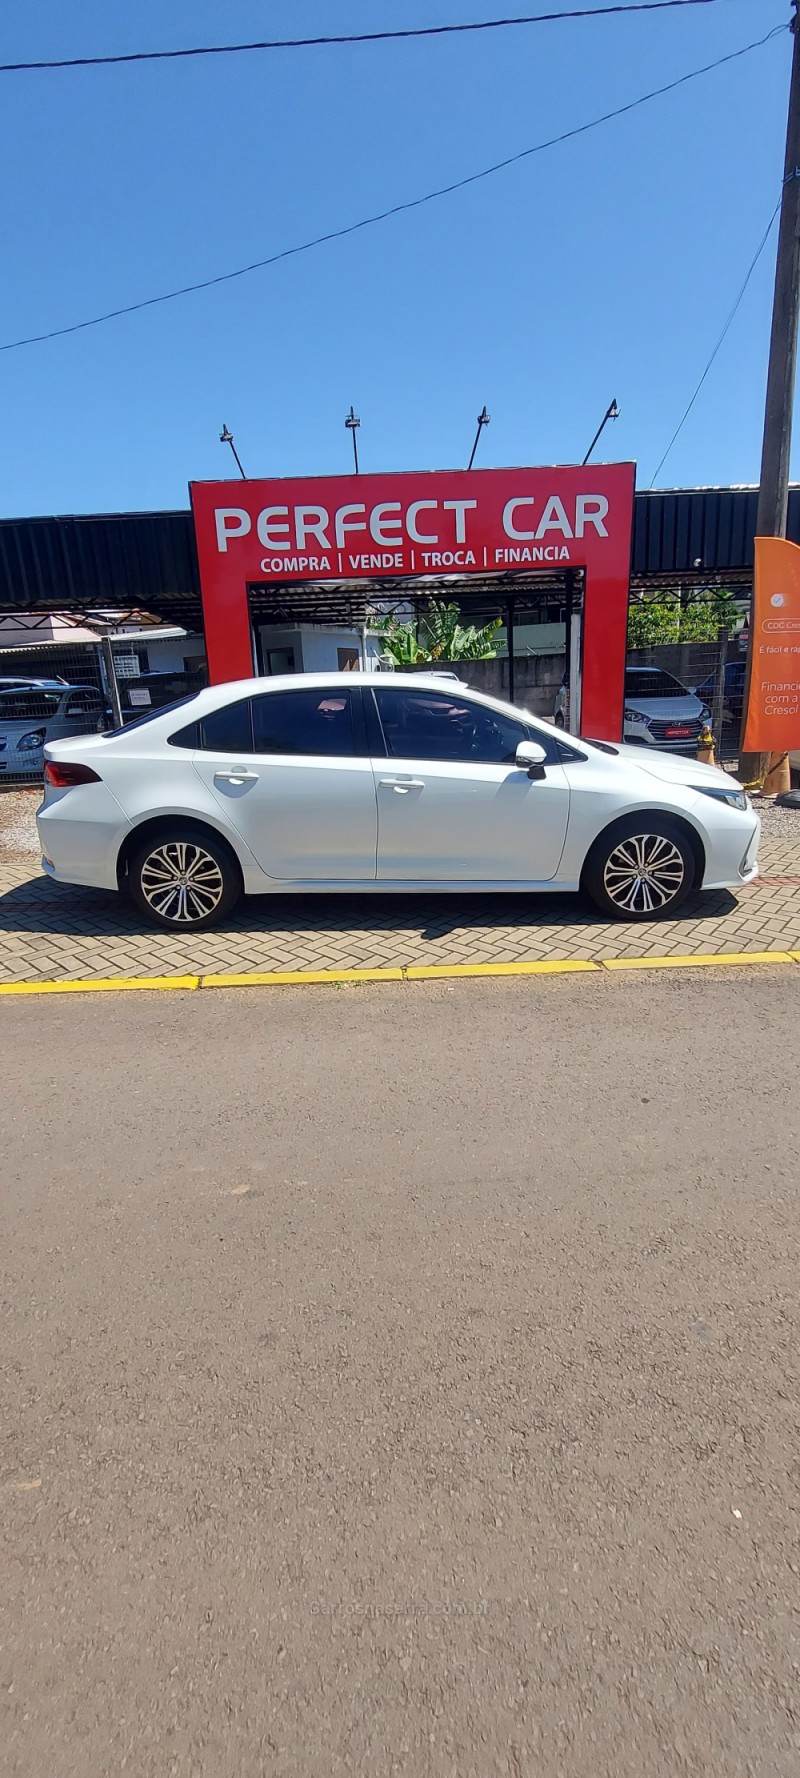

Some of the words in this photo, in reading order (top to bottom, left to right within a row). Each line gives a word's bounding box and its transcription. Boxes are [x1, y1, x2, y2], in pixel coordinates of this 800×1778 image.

[214, 500, 478, 553] PERFECT
[502, 494, 609, 541] CAR
[260, 556, 332, 573] COMPRA
[348, 553, 404, 569] VENDE
[421, 550, 476, 567] TROCA
[495, 546, 571, 563] FINANCIA
[766, 645, 782, 654] fácil
[761, 680, 800, 692] Financi
[765, 695, 789, 704] com
[791, 695, 798, 703] a
[765, 704, 799, 715] Cresol
